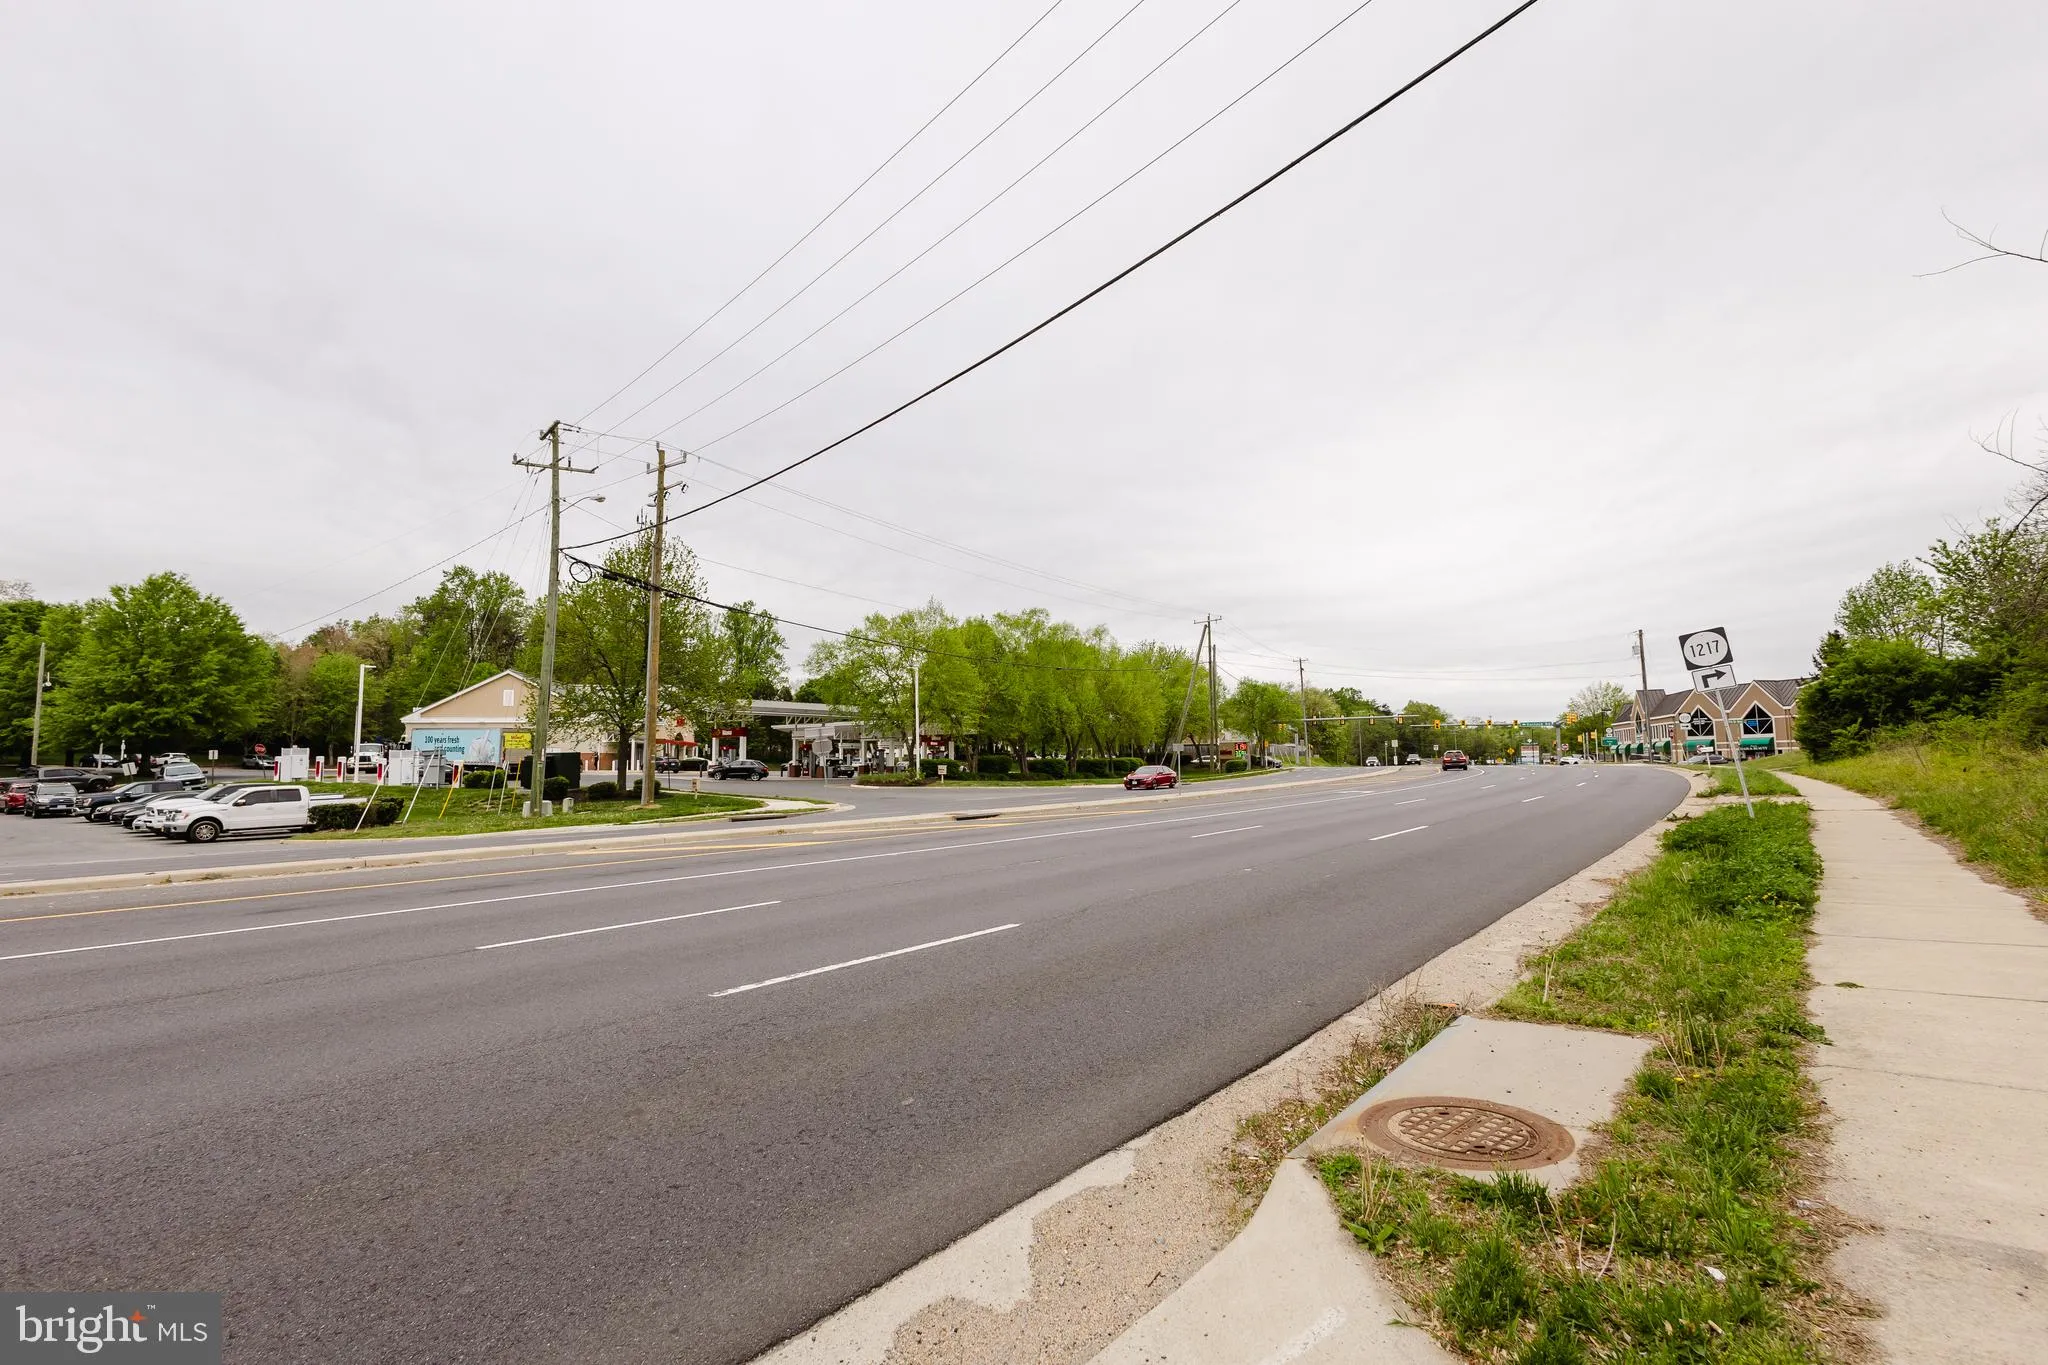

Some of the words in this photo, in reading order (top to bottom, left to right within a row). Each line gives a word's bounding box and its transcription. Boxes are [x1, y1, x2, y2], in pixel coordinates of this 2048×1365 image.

[1690, 640, 1719, 657] 1217
[434, 737, 447, 745] years
[444, 745, 465, 754] counting
